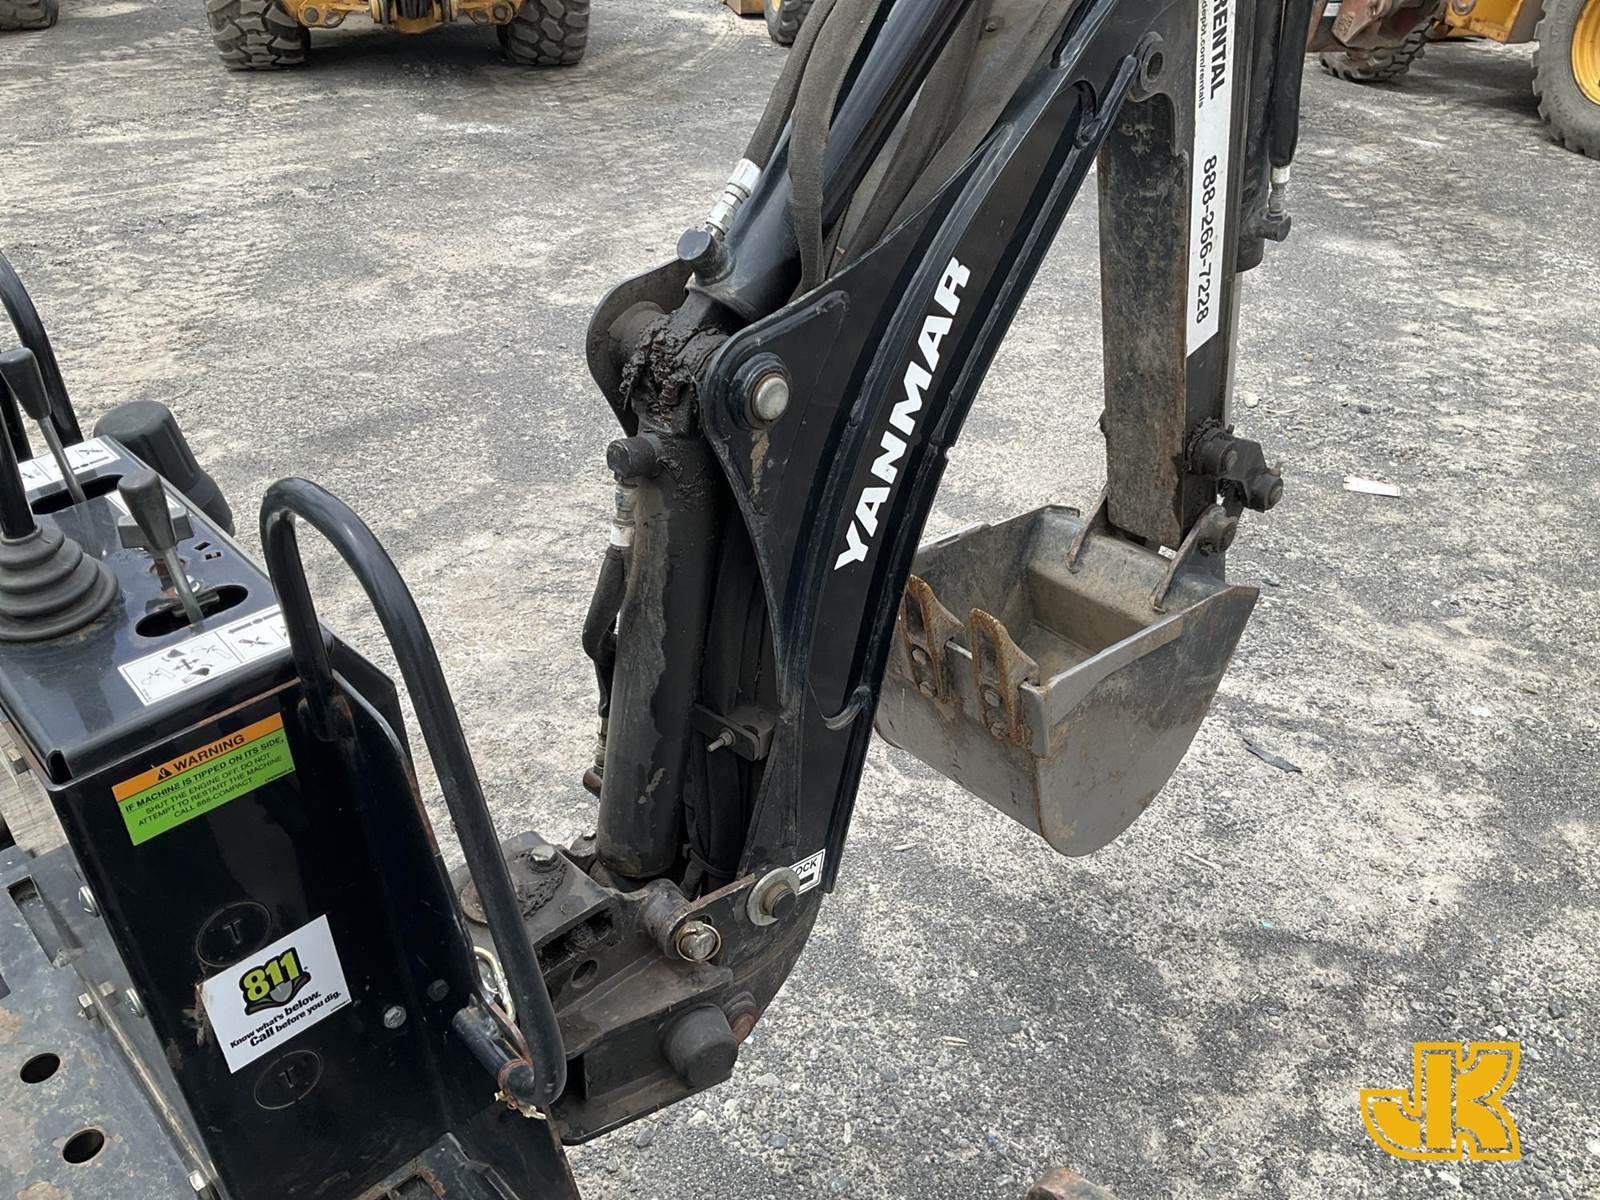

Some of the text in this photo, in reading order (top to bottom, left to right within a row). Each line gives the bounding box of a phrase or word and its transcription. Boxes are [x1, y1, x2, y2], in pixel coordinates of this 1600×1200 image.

[1210, 0, 1228, 100] RENTAL
[1196, 154, 1218, 324] 888-266-7228
[834, 256, 971, 570] YANMAR
[125, 803, 135, 812] IF
[136, 783, 180, 807] MACHINE
[182, 777, 193, 786] IS
[193, 761, 227, 781] TIPPED
[228, 754, 243, 765] ON
[244, 746, 259, 758] ITS
[173, 734, 245, 771] WARNING
[138, 805, 176, 826] ATTEMPT
[177, 799, 189, 808] TO
[190, 781, 227, 802] RESTART
[227, 774, 245, 785] THE
[246, 755, 282, 776] MACHINE
[145, 799, 168, 814] SHUT
[170, 791, 187, 803] THE
[188, 775, 219, 794] ENGINE
[240, 761, 253, 771] DO
[254, 753, 271, 764] NOT
[174, 805, 195, 818] CALL
[795, 857, 818, 876] OCK
[241, 949, 301, 1002] 811
[230, 1029, 255, 1048] Know
[255, 1013, 284, 1033] what's
[284, 991, 322, 1016] below.
[250, 1026, 275, 1047] Call
[275, 1011, 306, 1033] before
[306, 999, 324, 1016] you
[324, 991, 342, 1008] dig.
